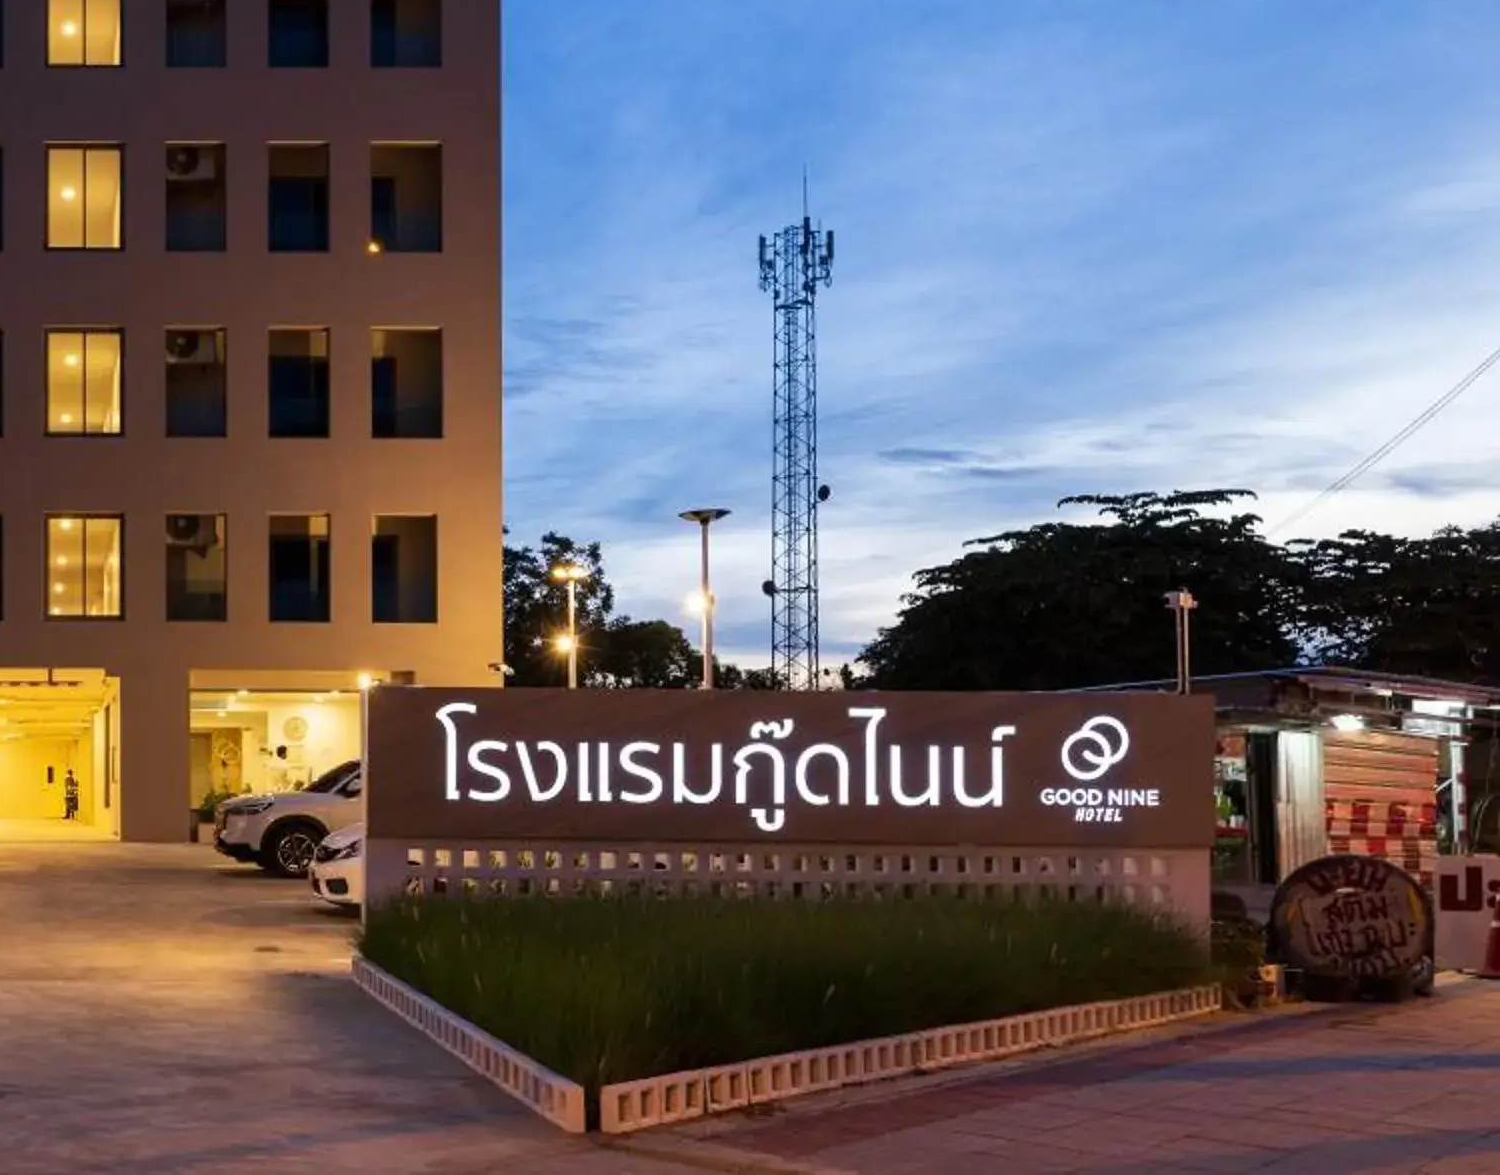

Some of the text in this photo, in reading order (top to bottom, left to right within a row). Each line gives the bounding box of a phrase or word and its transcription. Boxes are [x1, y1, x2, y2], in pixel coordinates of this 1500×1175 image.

[435, 702, 1016, 832] โรงแรมกู๊ดไนน์
[1040, 788, 1160, 806] GOOD NINE
[1075, 807, 1123, 823] HOTEL
